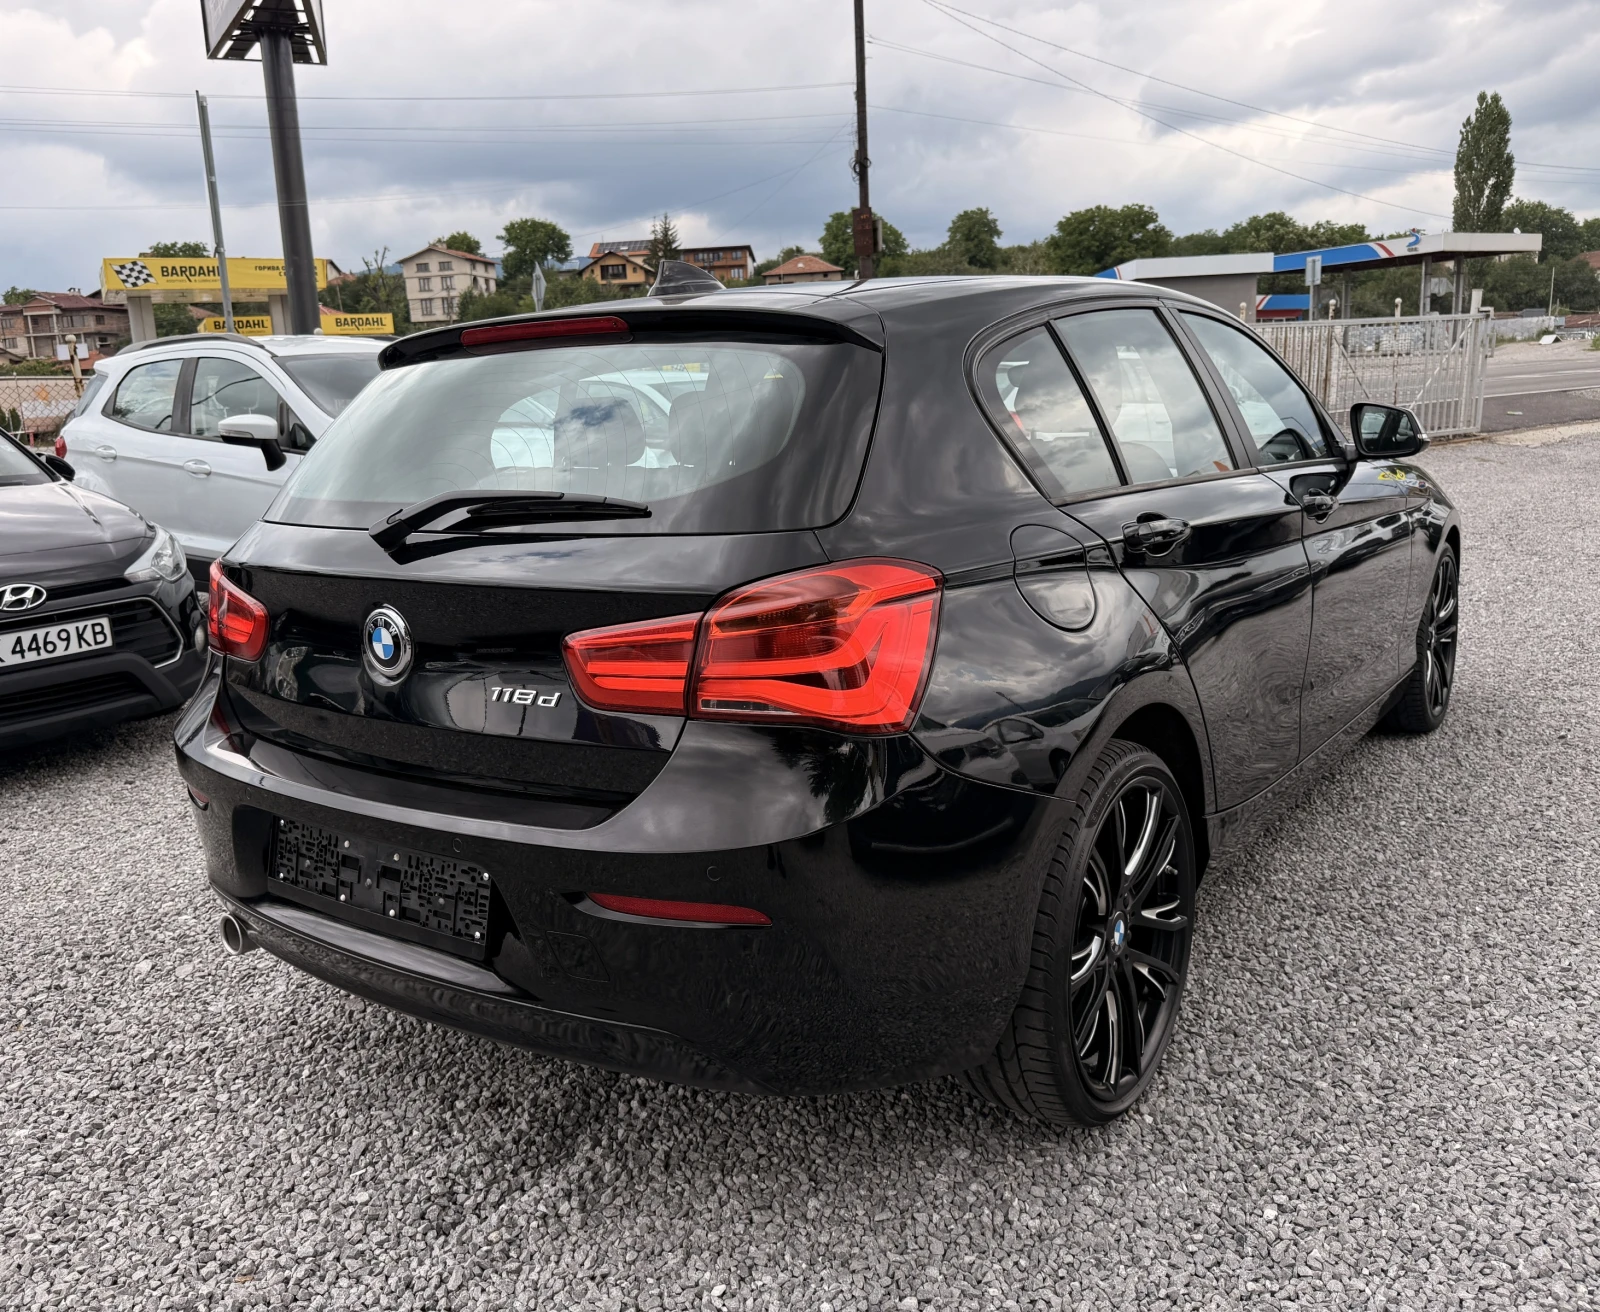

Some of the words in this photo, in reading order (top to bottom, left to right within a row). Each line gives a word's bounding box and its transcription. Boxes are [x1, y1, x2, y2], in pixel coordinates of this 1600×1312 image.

[335, 316, 387, 331] BARDAHL
[11, 628, 71, 660] 4469
[75, 622, 108, 649] KB
[491, 686, 563, 708] 118d
